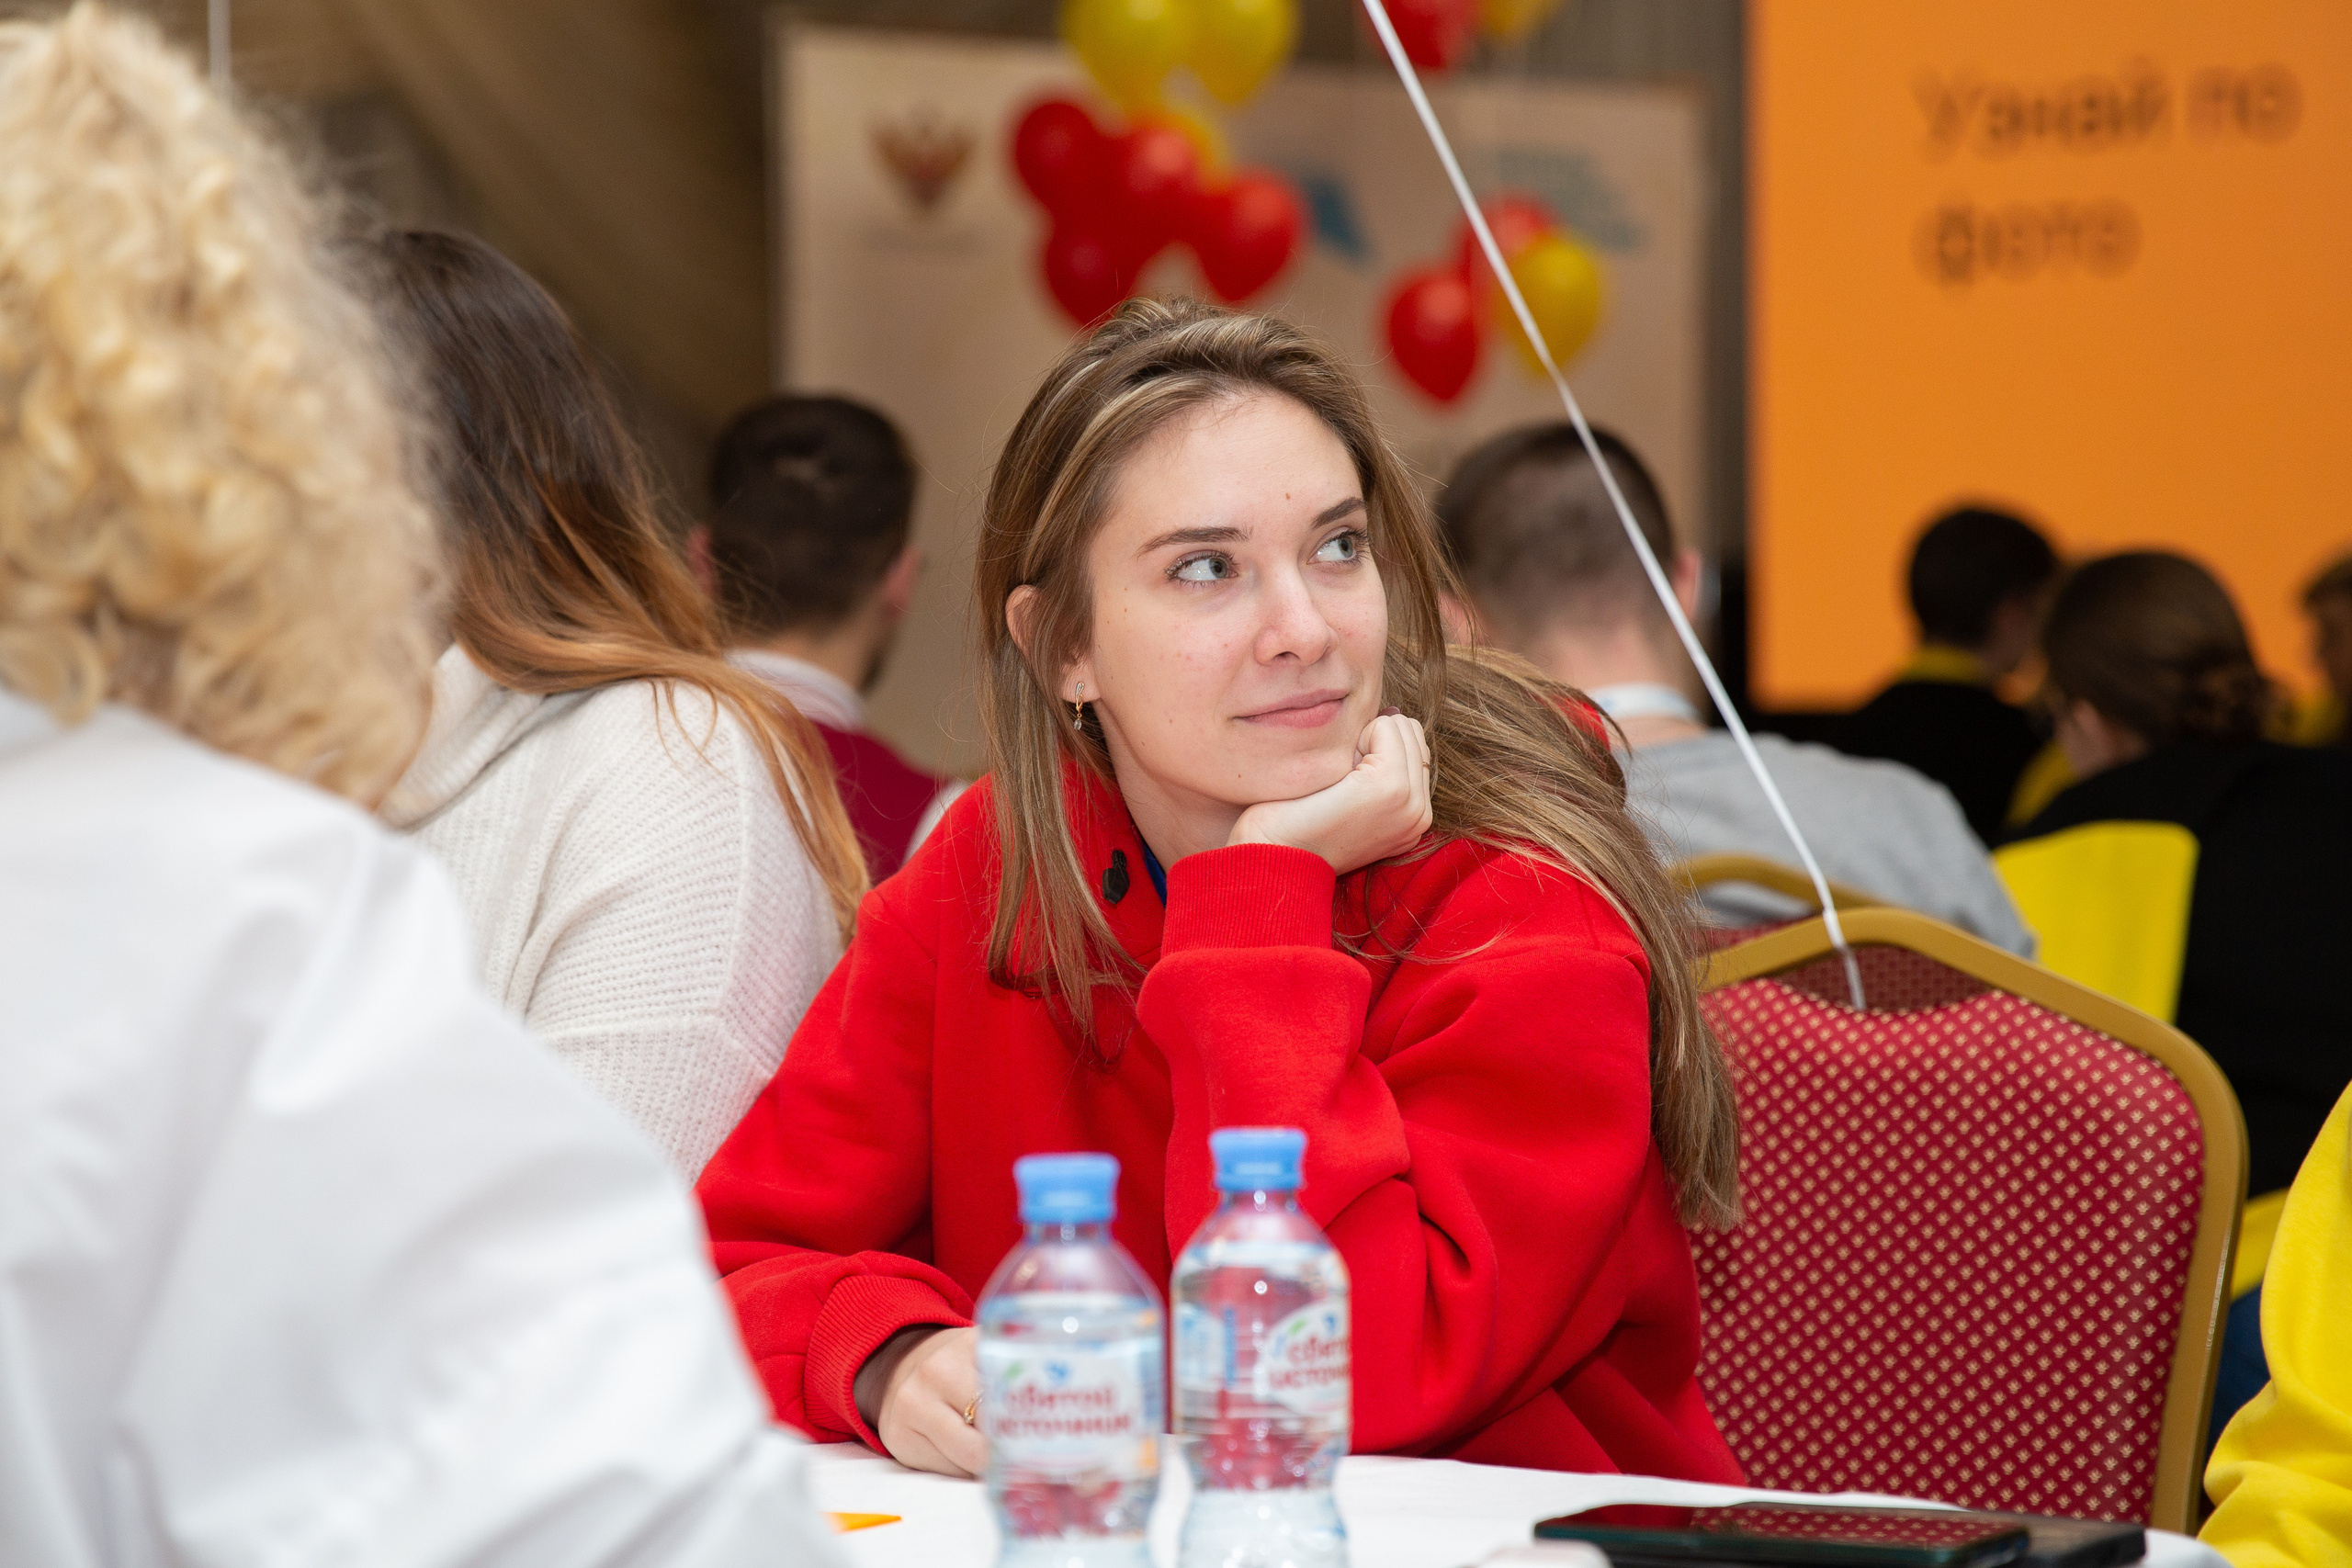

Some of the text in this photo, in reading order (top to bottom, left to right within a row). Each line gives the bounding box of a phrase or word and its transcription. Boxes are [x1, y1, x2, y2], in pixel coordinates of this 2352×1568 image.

[1913, 57, 2301, 160] Узнай по
[1914, 197, 2141, 296] фото
